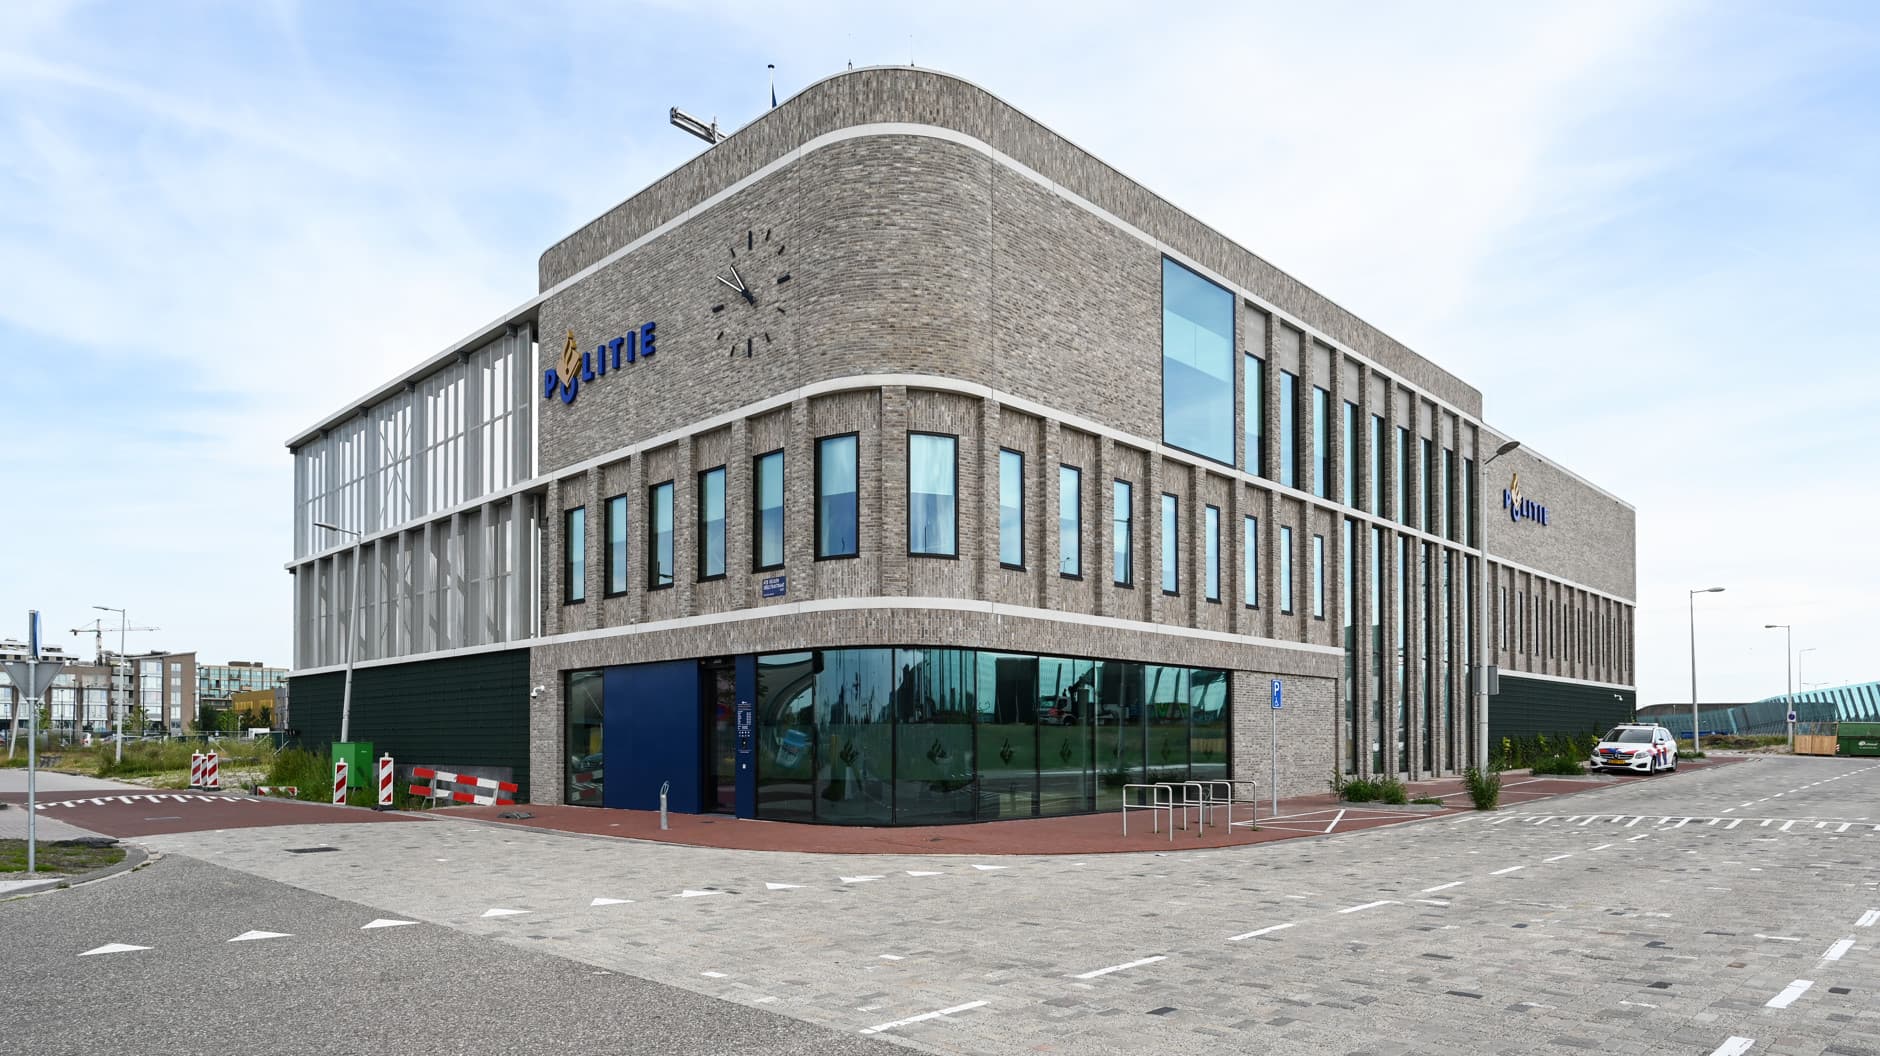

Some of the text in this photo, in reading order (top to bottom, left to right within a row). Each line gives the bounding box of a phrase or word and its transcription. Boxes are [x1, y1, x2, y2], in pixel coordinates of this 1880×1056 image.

[544, 321, 656, 404] POLITIE
[1503, 488, 1549, 526] POLITIE
[1274, 682, 1280, 696] P
